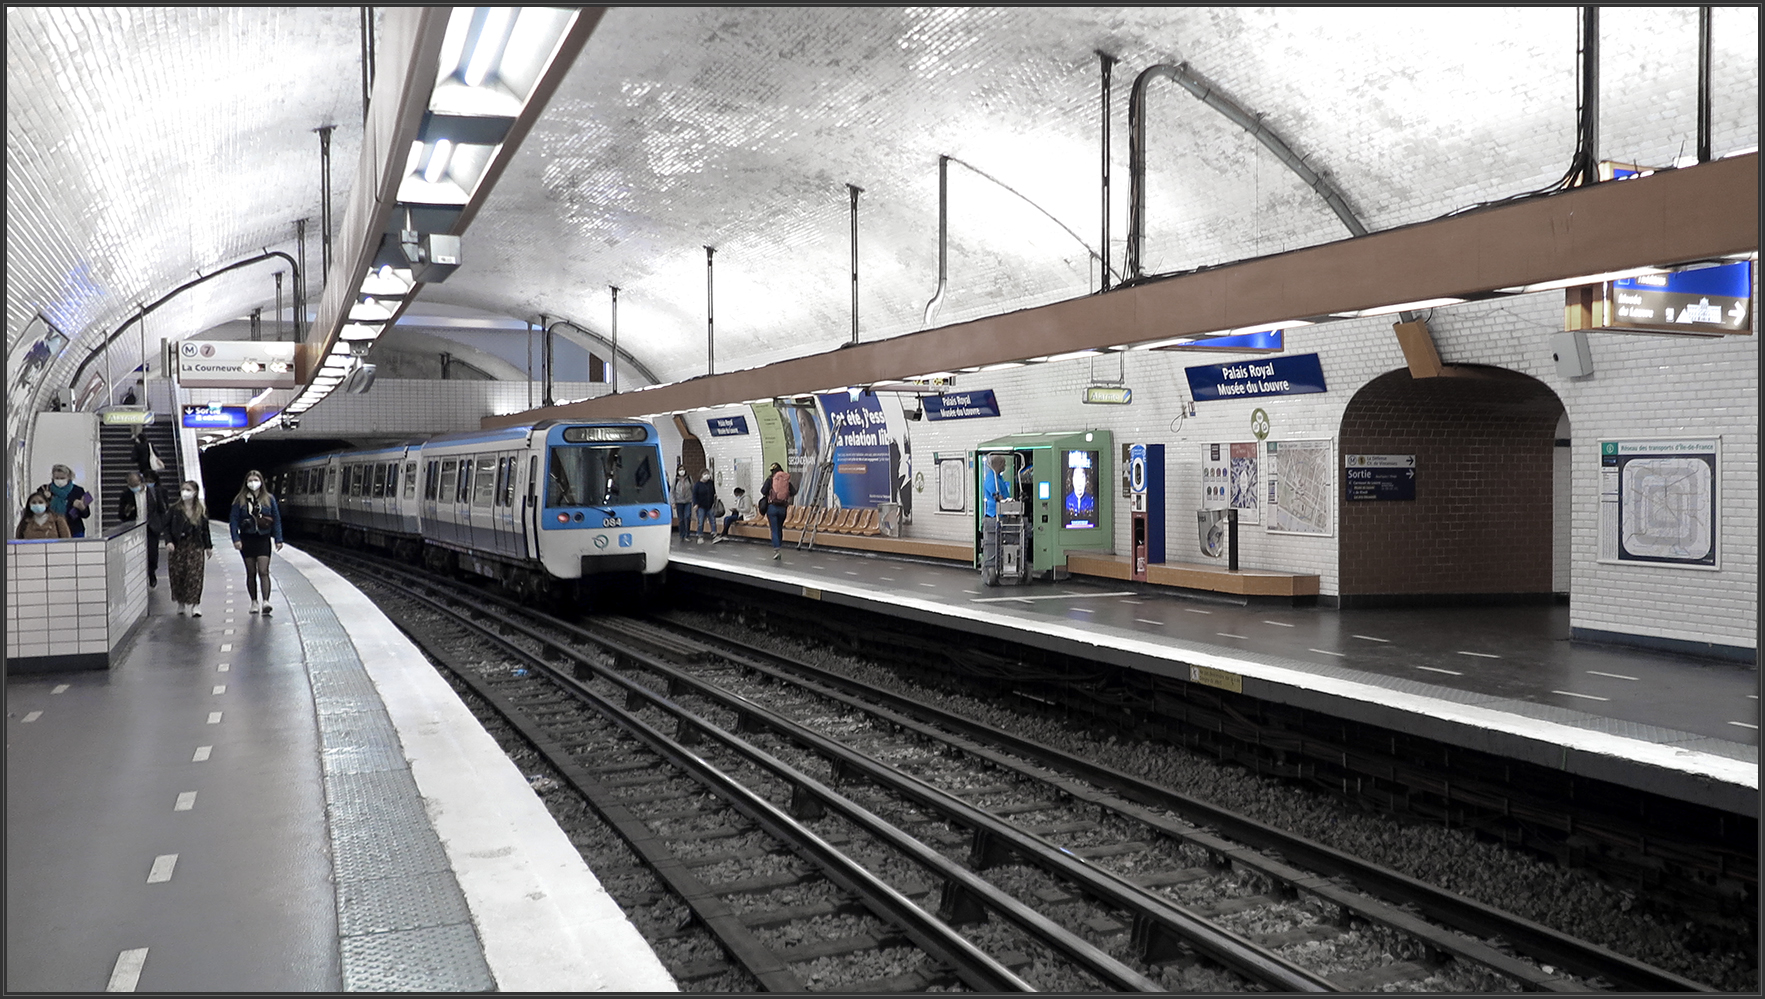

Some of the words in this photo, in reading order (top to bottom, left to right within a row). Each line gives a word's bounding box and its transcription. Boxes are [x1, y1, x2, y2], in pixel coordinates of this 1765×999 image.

[182, 364, 192, 372] La
[195, 364, 242, 372] Courneuve
[1222, 366, 1248, 380] Palais
[1249, 362, 1275, 379] Royal
[1217, 381, 1245, 396] Musée
[1246, 381, 1258, 393] du
[1260, 380, 1290, 392] Louvre
[942, 396, 957, 406] Palais
[957, 394, 972, 407] Royal
[1091, 392, 1119, 401] Alarme
[940, 407, 957, 417] Musée
[963, 406, 980, 416] Louvre
[846, 408, 865, 428] été,
[844, 429, 878, 447] relation
[1649, 444, 1674, 454] transports
[1348, 470, 1371, 479] Sortie
[603, 518, 622, 527] 084
